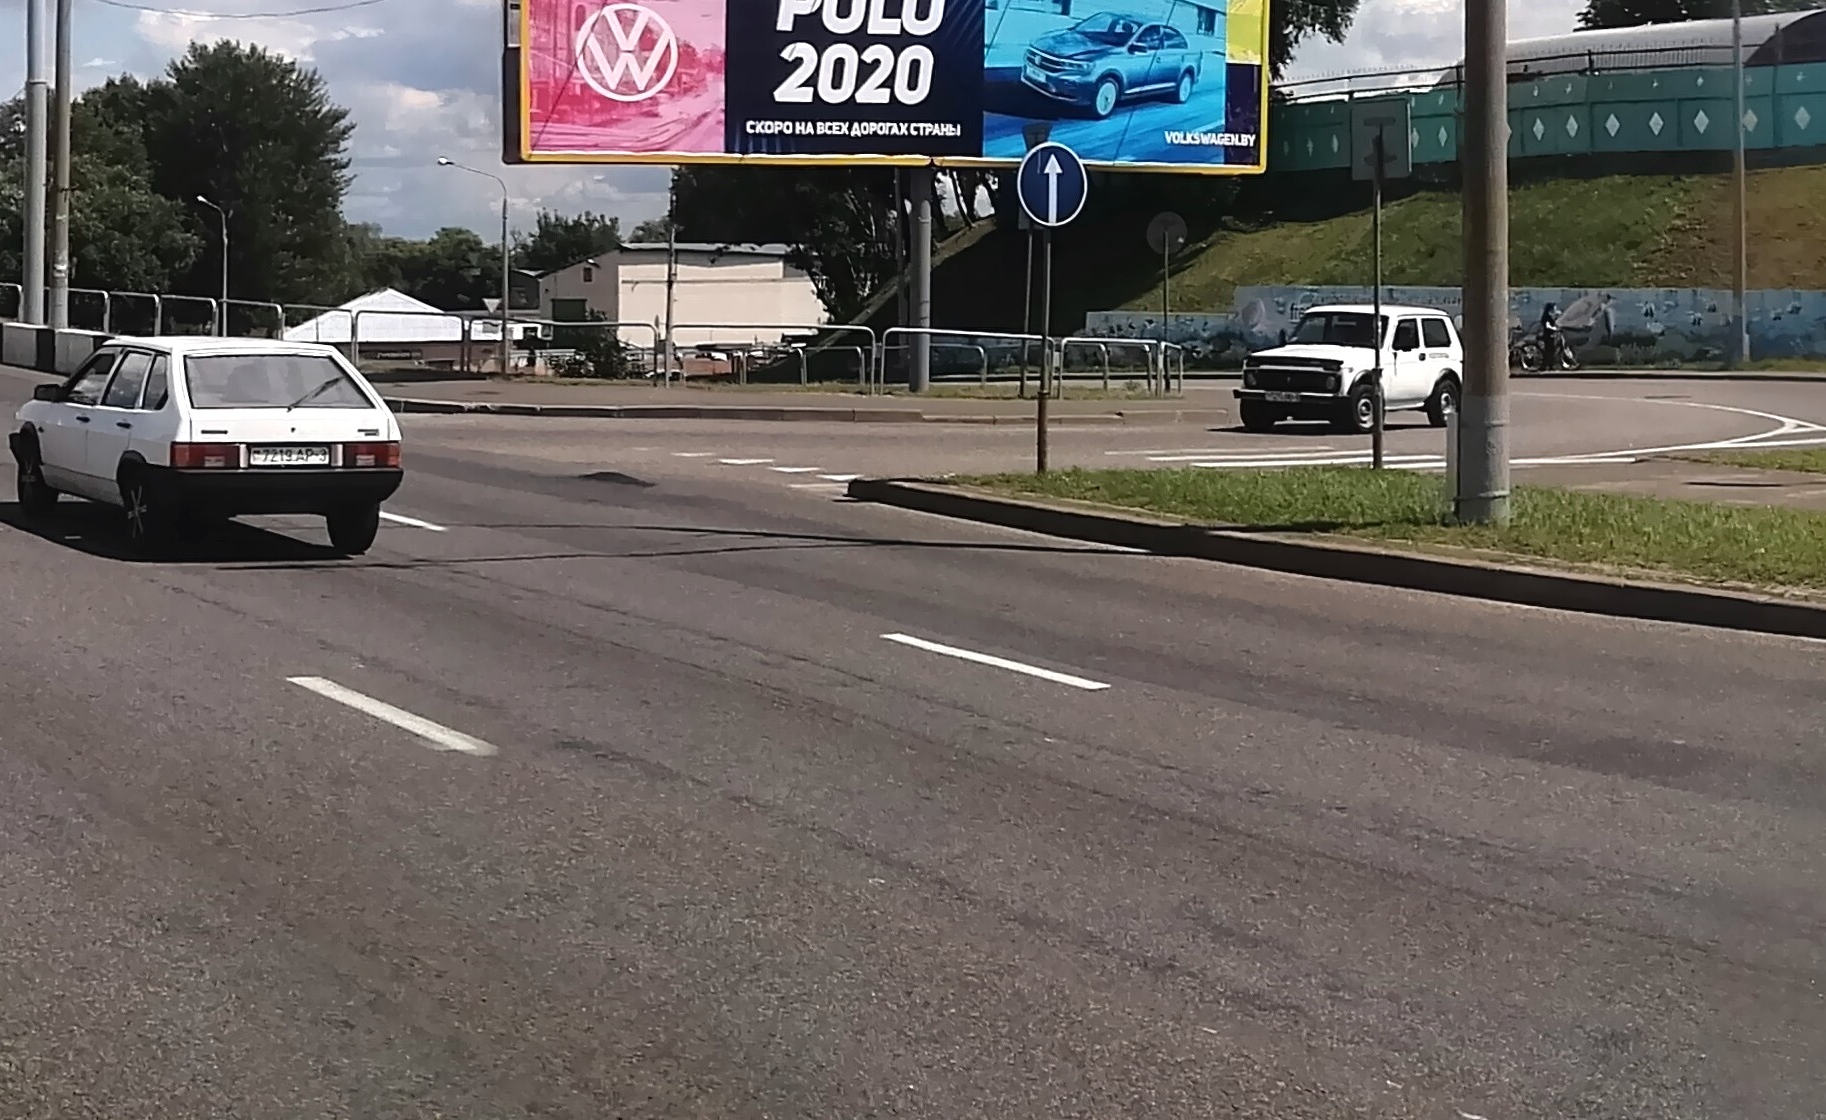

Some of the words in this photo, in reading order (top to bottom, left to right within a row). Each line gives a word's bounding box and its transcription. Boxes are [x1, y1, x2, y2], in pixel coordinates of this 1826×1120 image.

[773, 42, 934, 105] 2020
[745, 120, 793, 135] СКОРО
[795, 121, 815, 135] НА
[816, 121, 850, 136] ВСЕХ
[850, 122, 909, 138] ДОРОГАХ
[909, 123, 961, 137] СТРАНЫ
